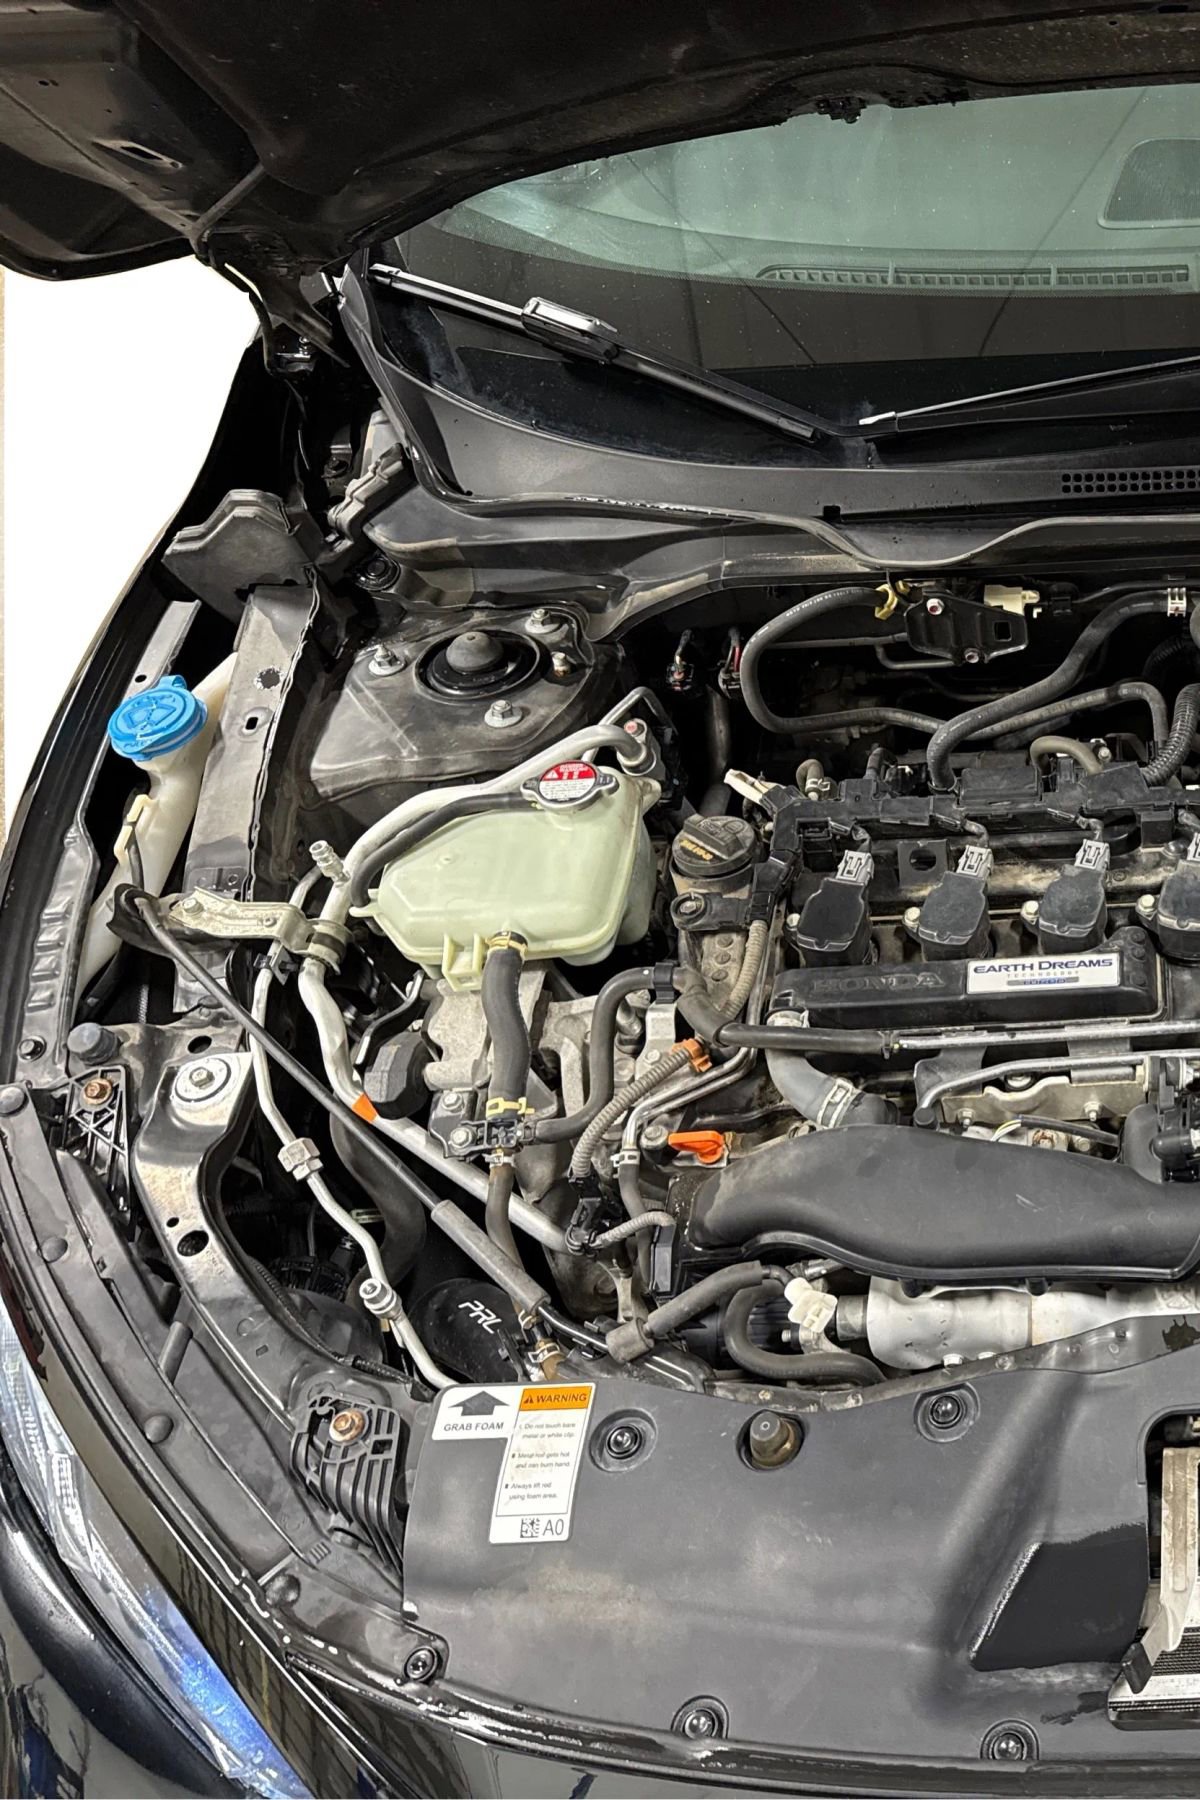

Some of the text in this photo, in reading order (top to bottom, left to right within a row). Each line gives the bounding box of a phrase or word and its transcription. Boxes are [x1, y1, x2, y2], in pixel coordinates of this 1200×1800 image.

[973, 958, 1113, 974] EARTH DREAMS
[812, 971, 946, 993] HONDA
[458, 1300, 502, 1335] PRL
[536, 1393, 587, 1403] WARNING
[443, 1422, 504, 1432] GRAB FOAM
